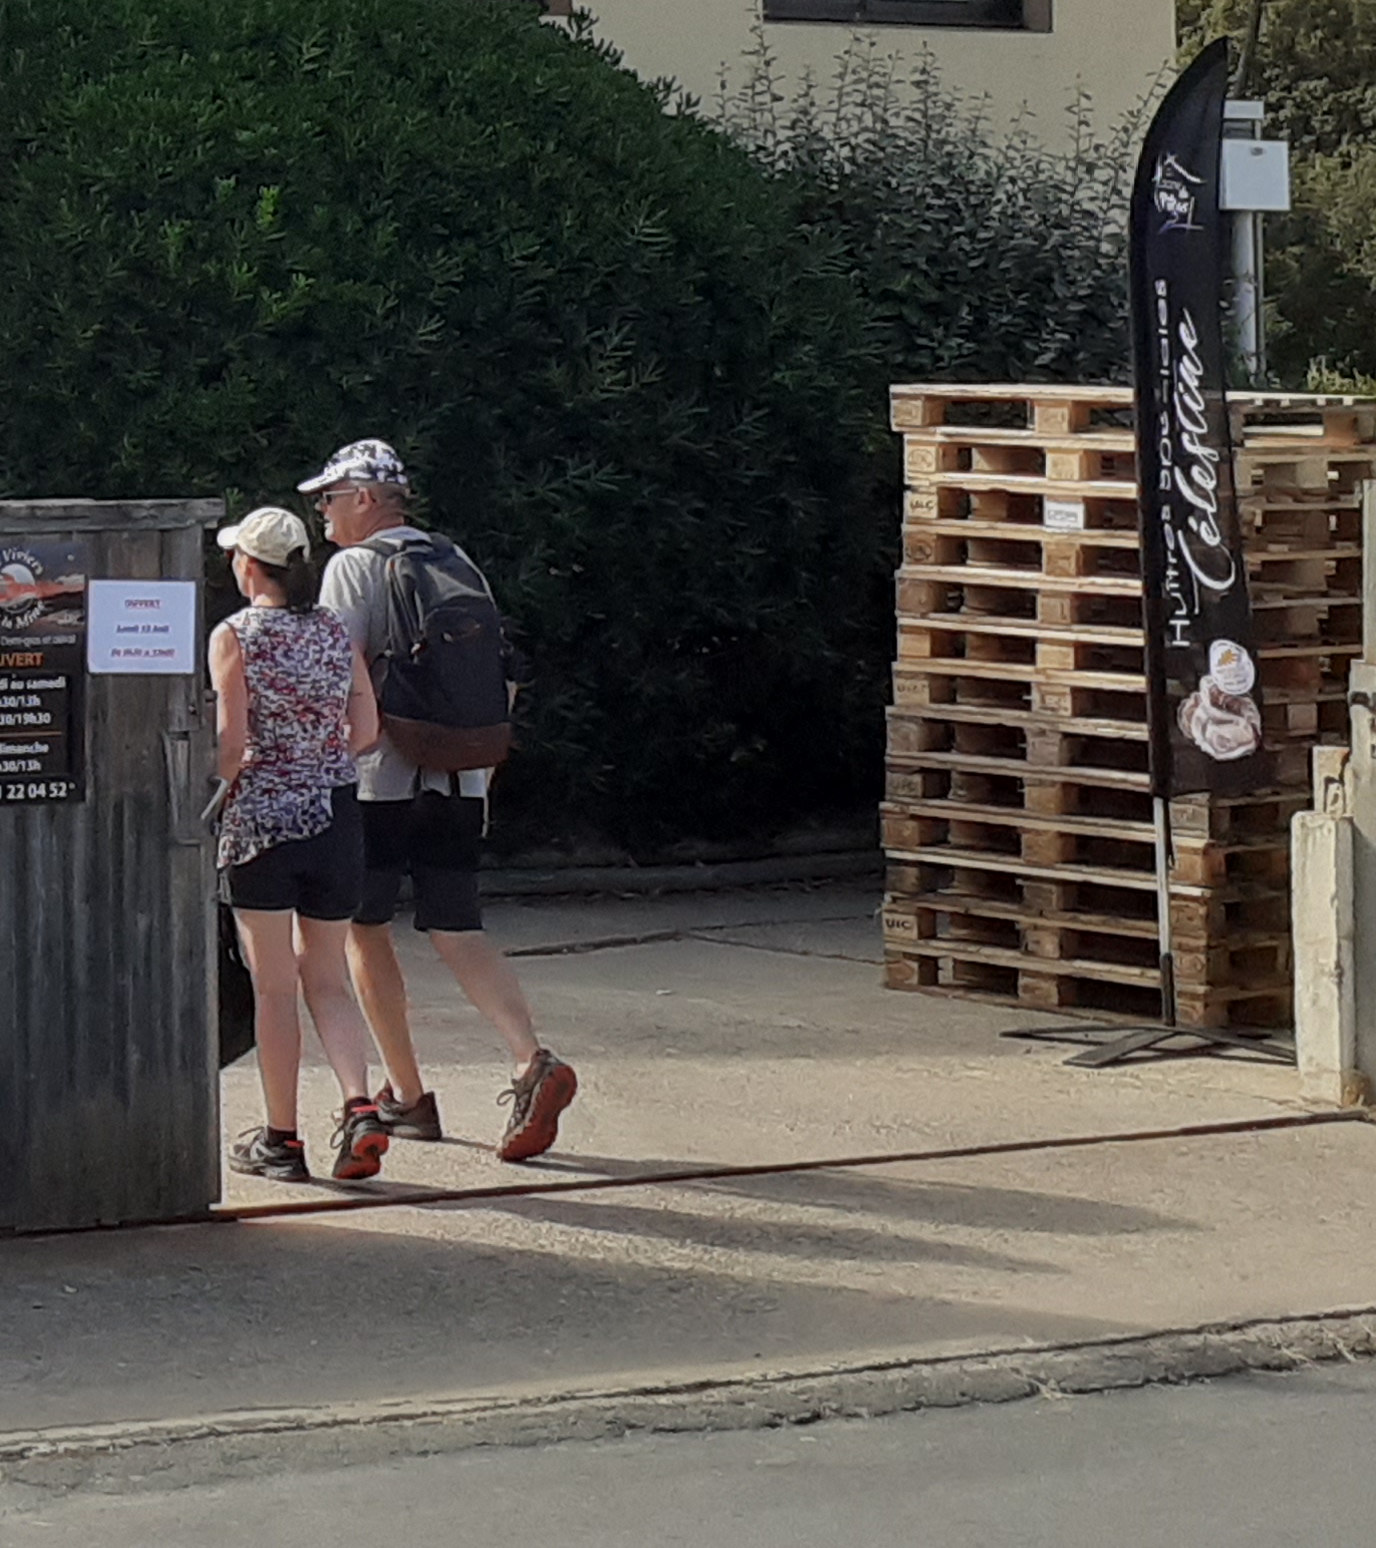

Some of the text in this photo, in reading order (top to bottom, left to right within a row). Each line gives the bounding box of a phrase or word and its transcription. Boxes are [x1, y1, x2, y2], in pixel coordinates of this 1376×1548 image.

[2, 547, 44, 575] Viviers
[6, 784, 25, 800] 22
[28, 782, 46, 798] 04
[49, 781, 67, 798] 52
